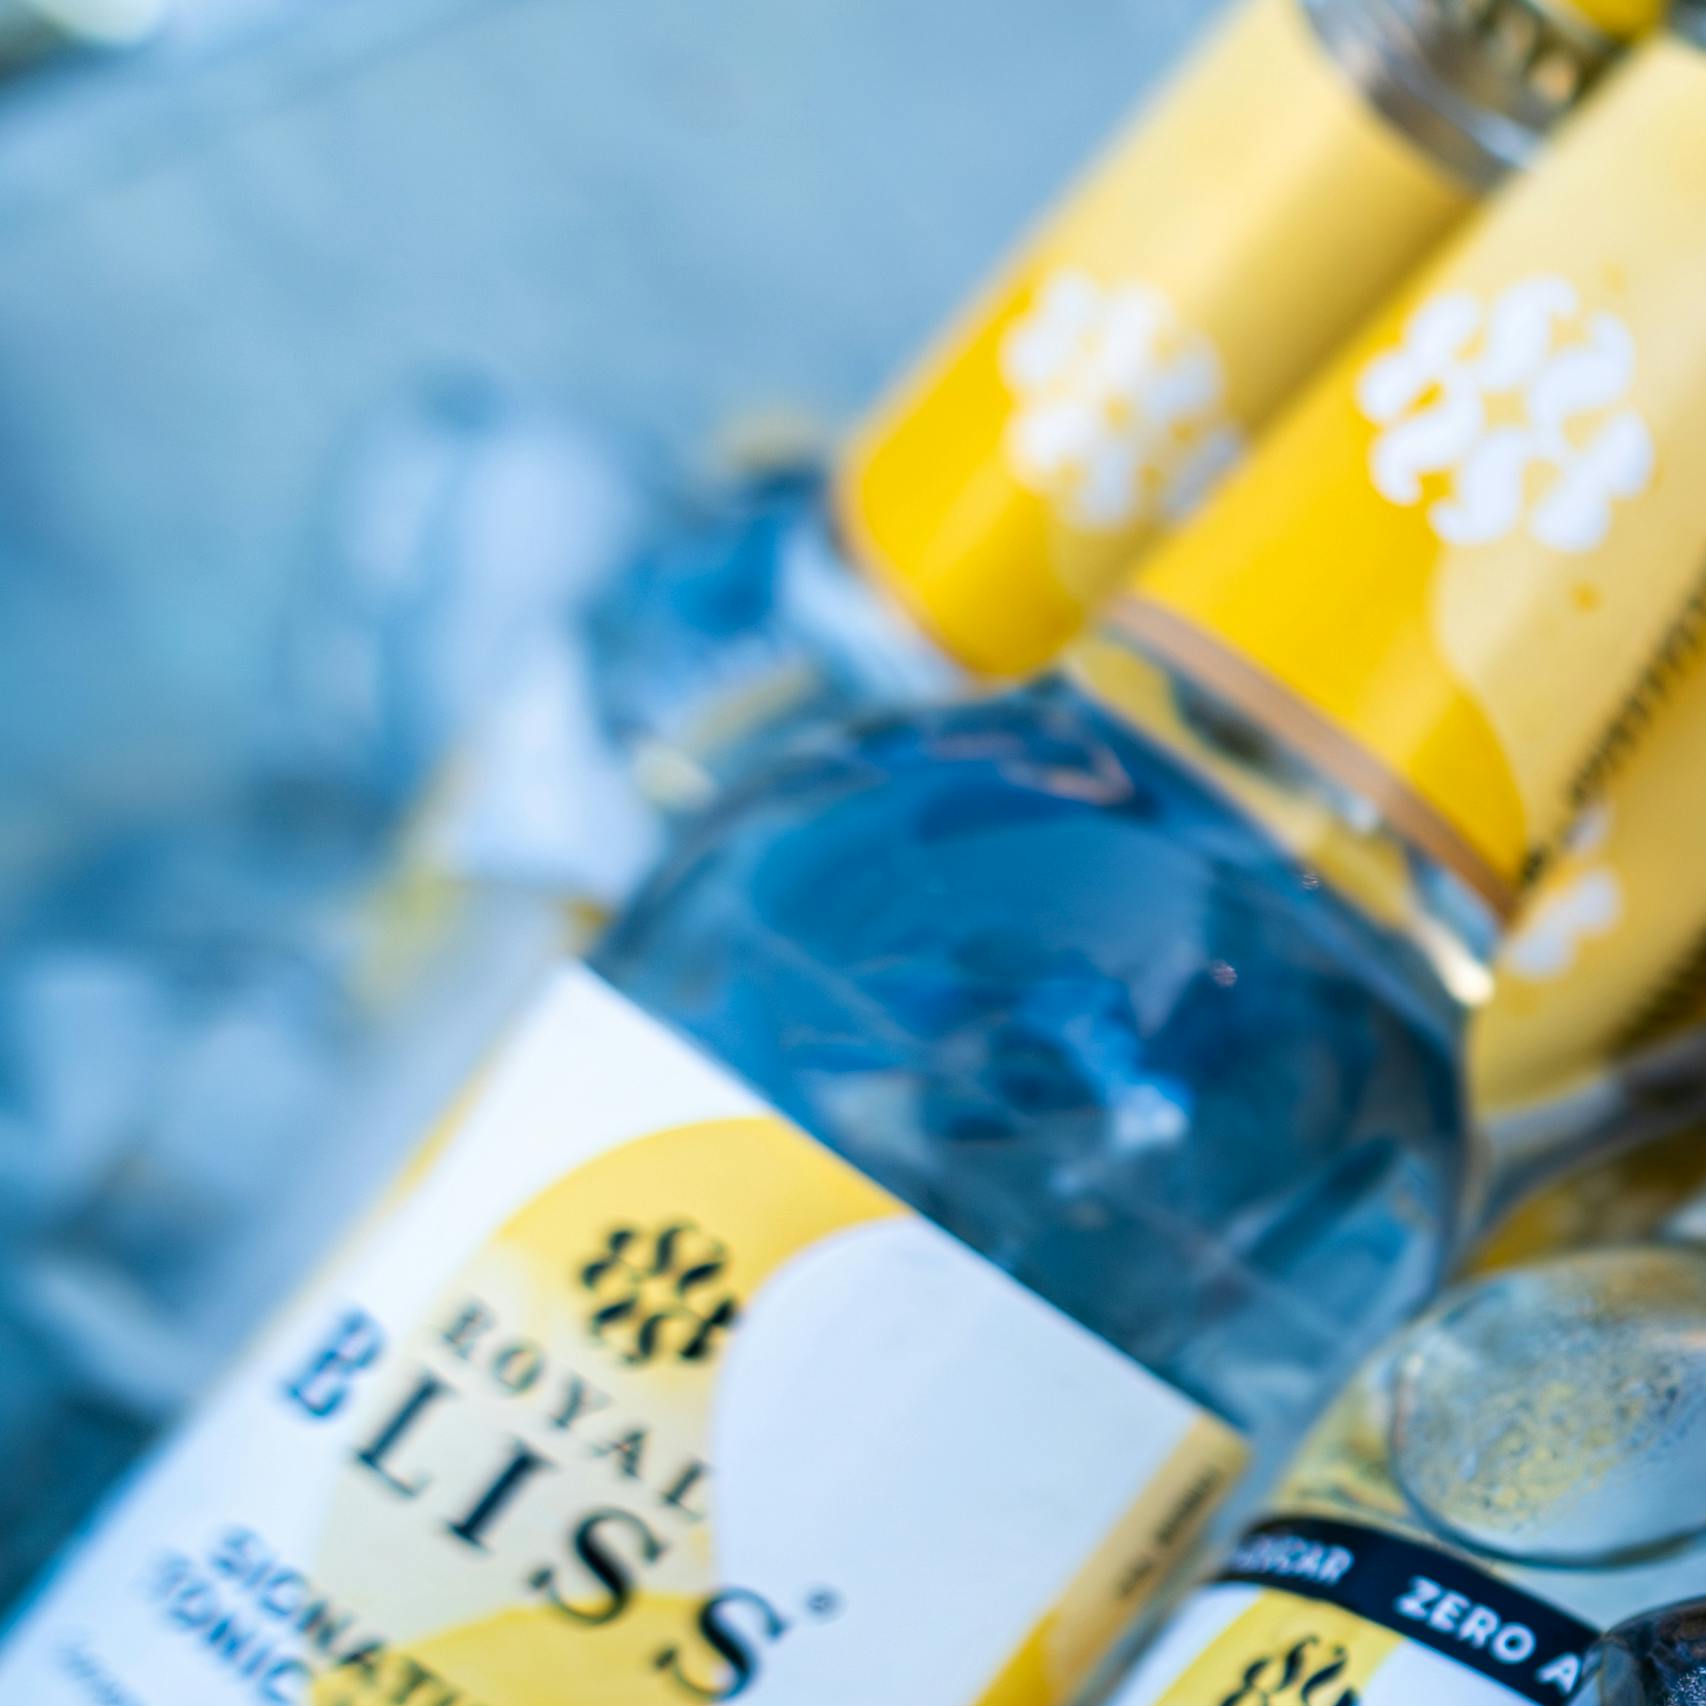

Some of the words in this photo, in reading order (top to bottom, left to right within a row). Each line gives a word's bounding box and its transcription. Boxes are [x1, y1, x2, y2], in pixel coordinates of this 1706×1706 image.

[280, 1304, 791, 1705] BLISS
[435, 1295, 712, 1525] ROYAL
[1394, 1574, 1537, 1666] ZERO
